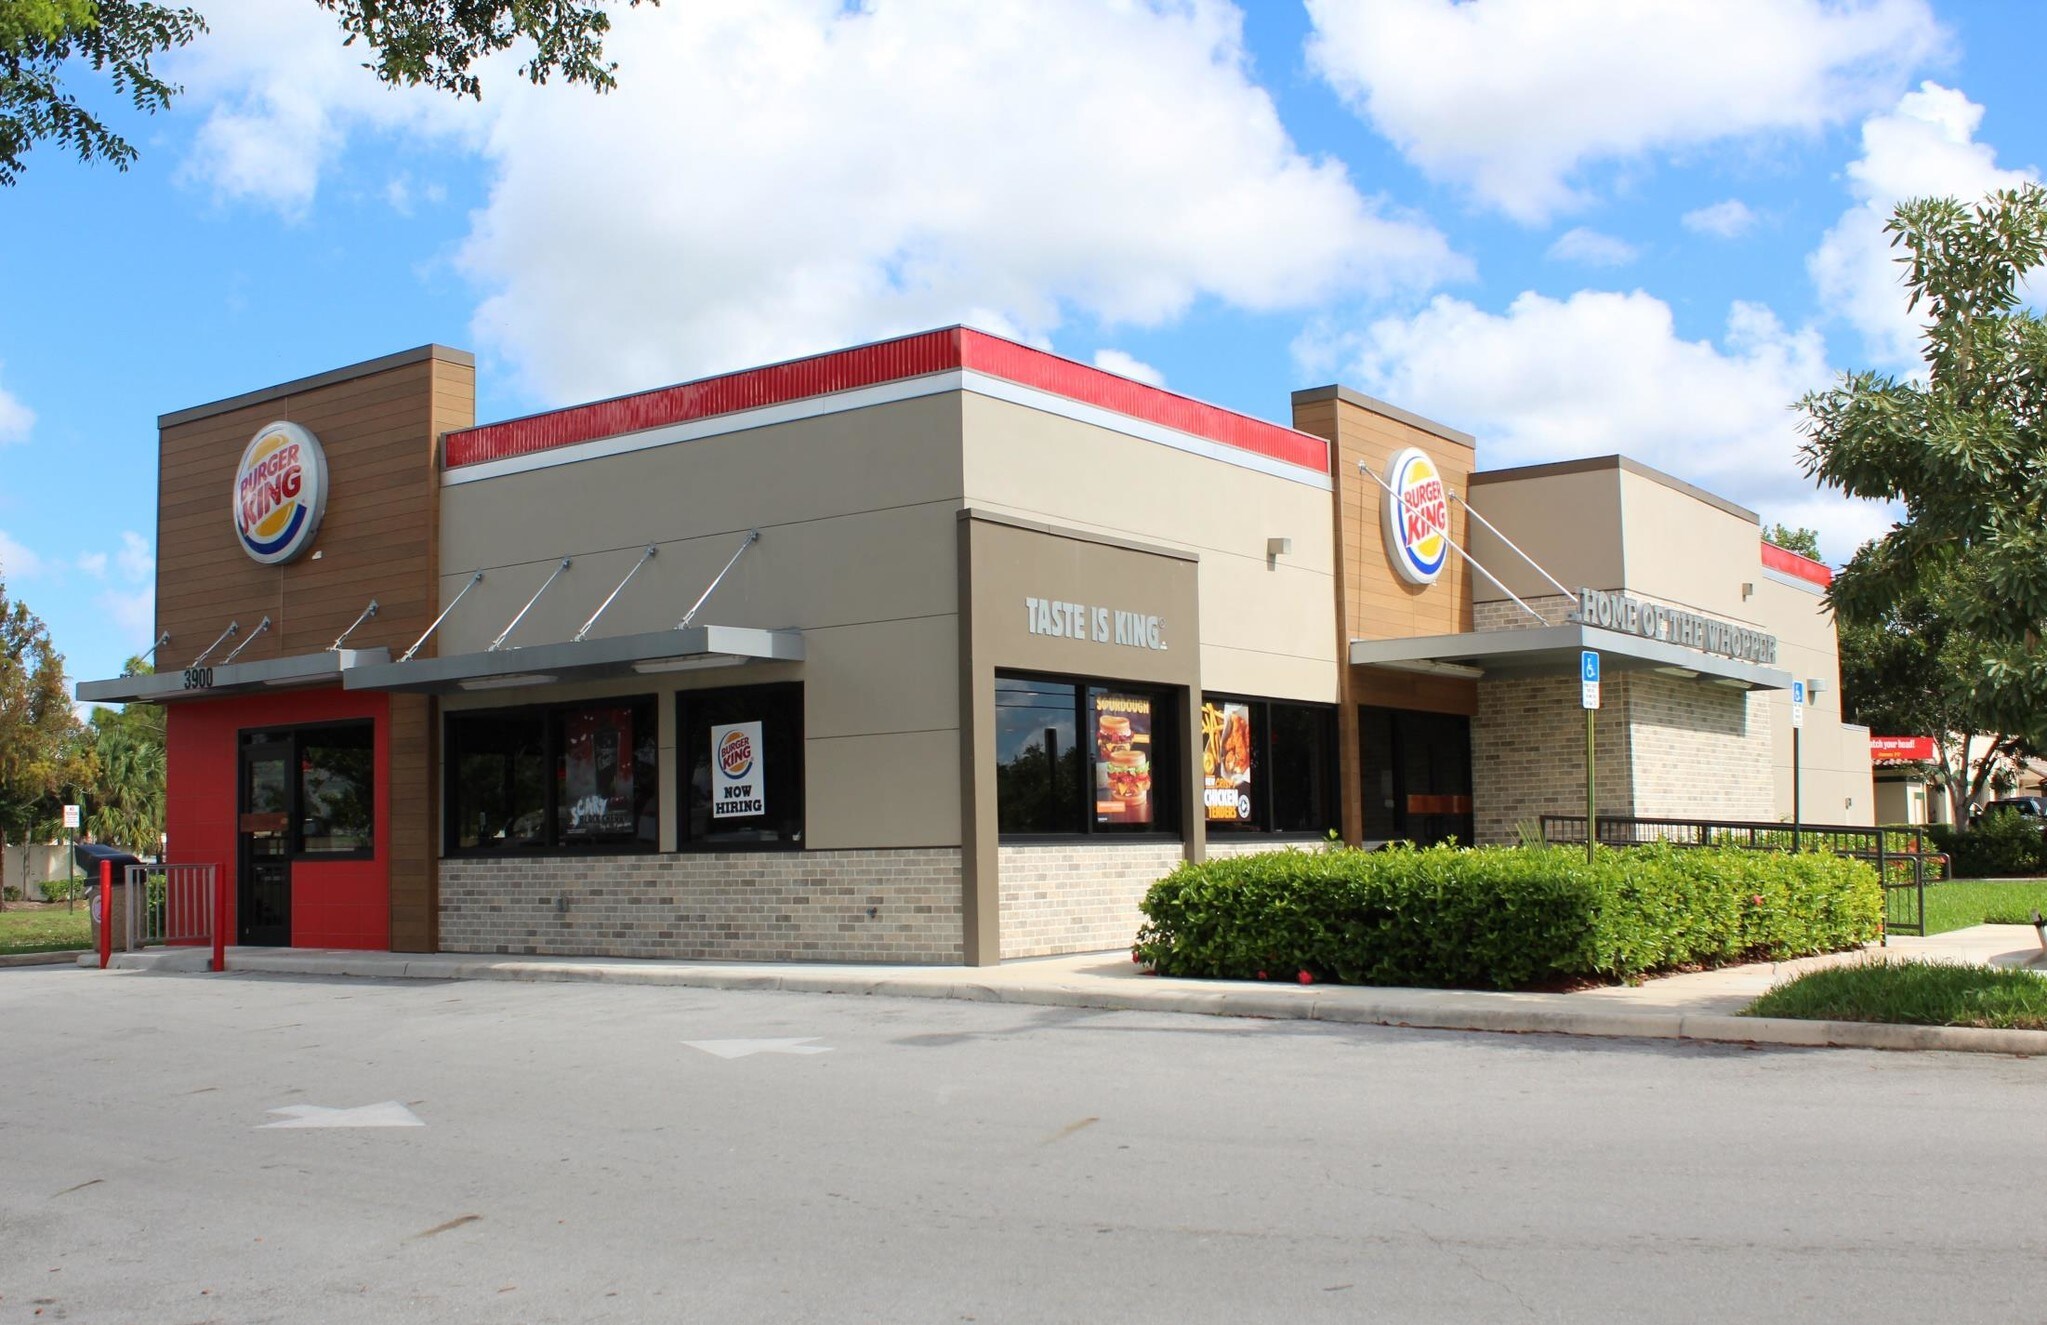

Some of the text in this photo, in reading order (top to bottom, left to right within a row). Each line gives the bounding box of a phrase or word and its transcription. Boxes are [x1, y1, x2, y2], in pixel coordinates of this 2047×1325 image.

[242, 464, 302, 534] KING
[1404, 480, 1442, 513] BURGER
[1406, 500, 1446, 545] KING
[1025, 597, 1086, 640] TASTE
[1091, 606, 1109, 643] IS
[1582, 587, 1777, 664] HOME OF THE WHOPPER
[184, 667, 213, 689] 3900
[1096, 697, 1150, 714] SOURDOUGH
[721, 737, 749, 757] BURGER
[1883, 741, 1897, 749] your
[1898, 740, 1915, 748] head!
[722, 746, 751, 770] KING
[724, 785, 752, 798] NOW
[1204, 789, 1238, 806] CHICKEN
[715, 799, 762, 814] HIRING
[1209, 806, 1237, 818] TENDERS
